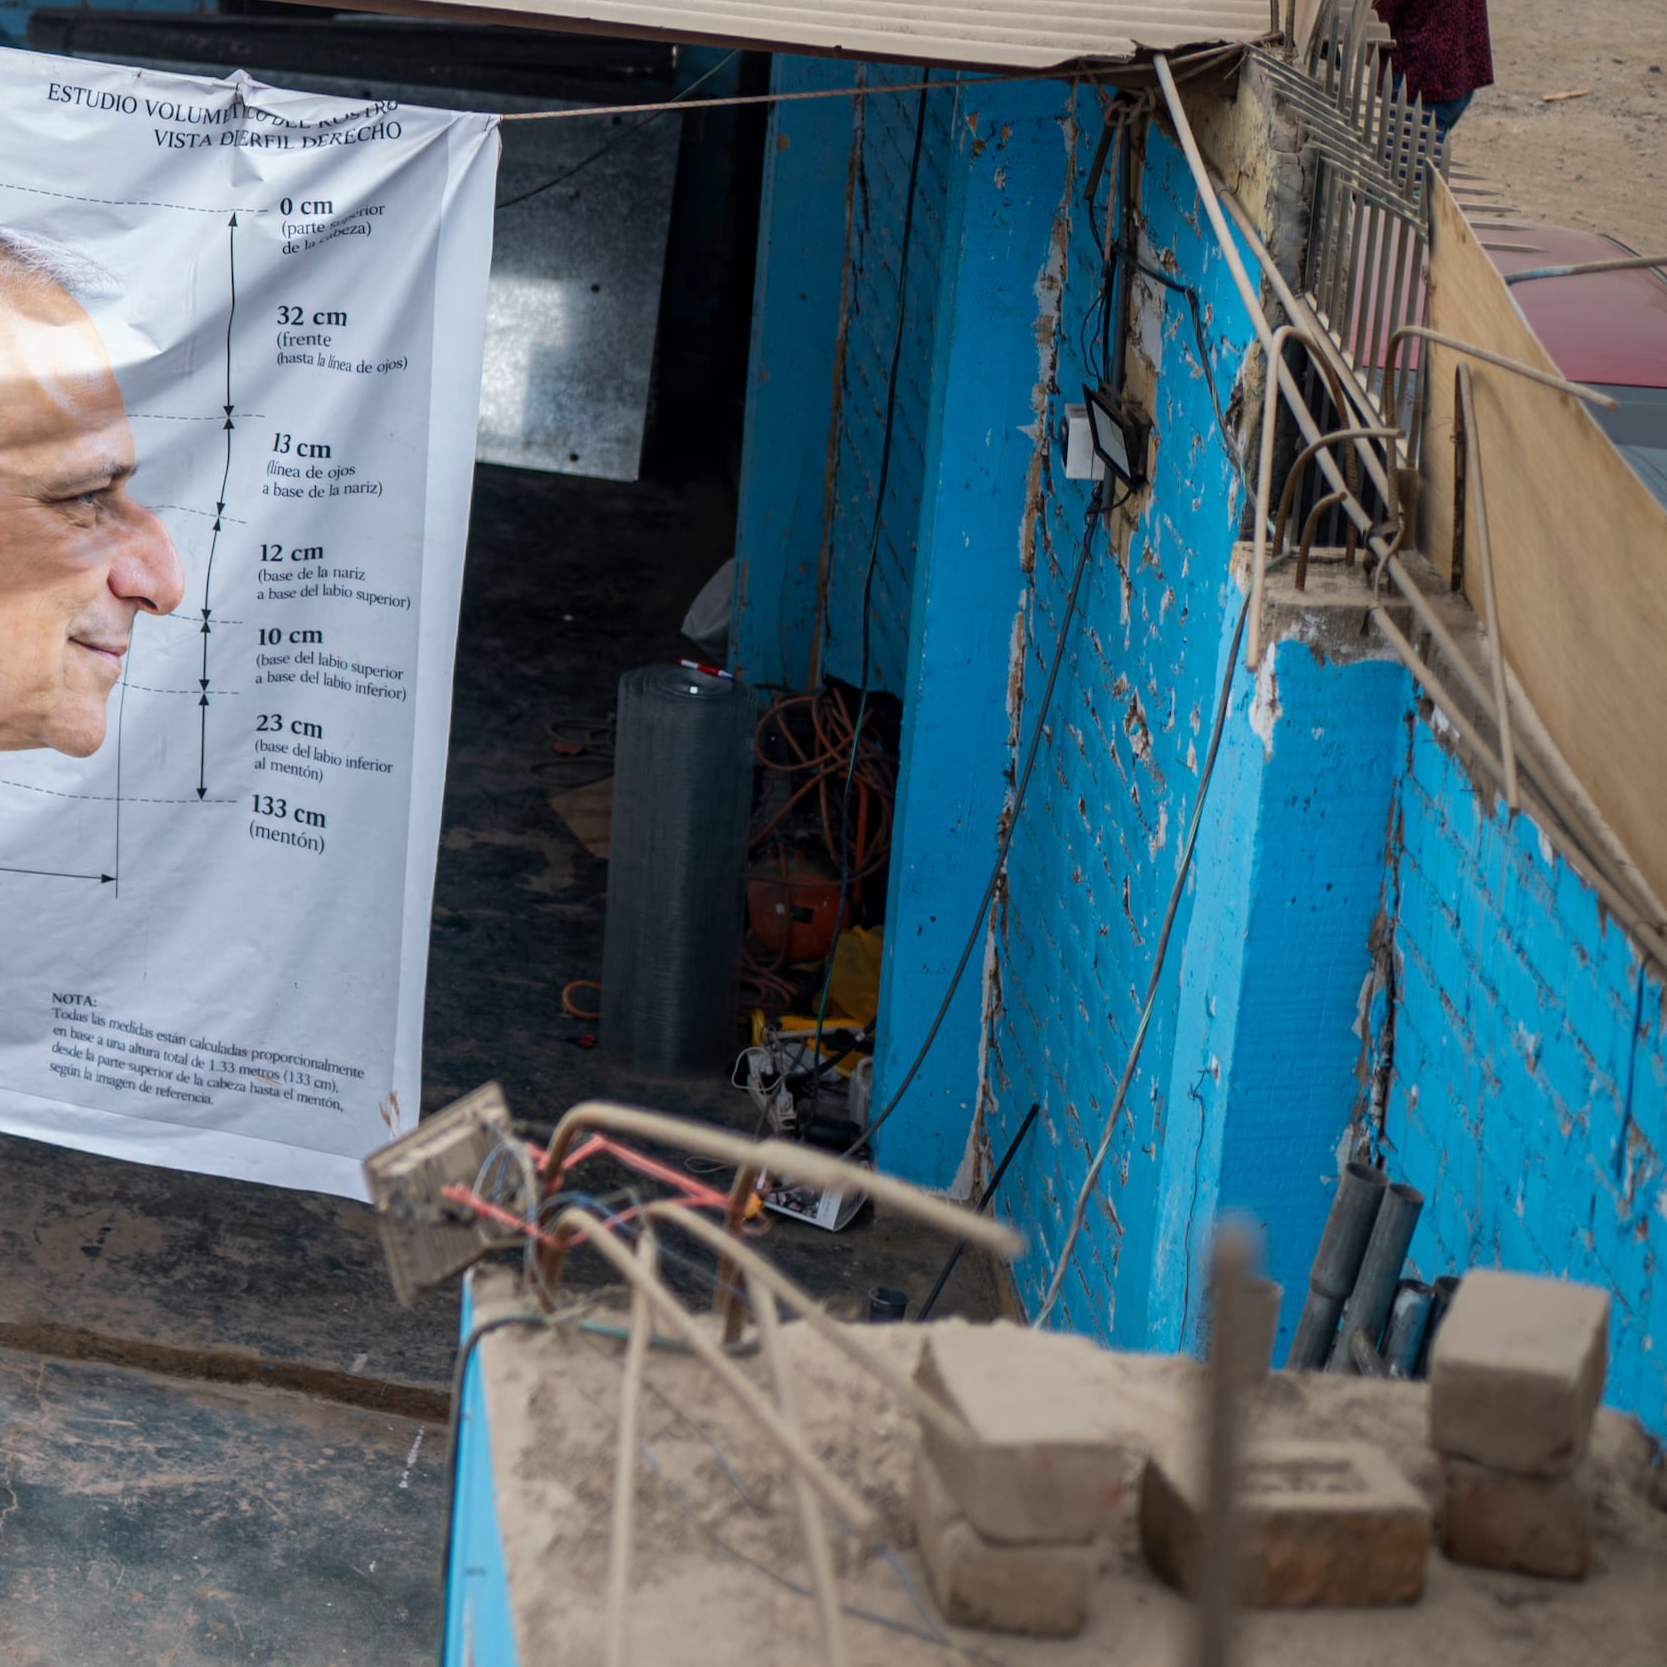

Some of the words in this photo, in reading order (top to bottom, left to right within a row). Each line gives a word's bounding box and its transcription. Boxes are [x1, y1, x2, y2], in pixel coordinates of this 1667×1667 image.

[48, 84, 138, 114] ESTUDIO
[155, 129, 213, 149] VISTA
[302, 121, 402, 149] DERECHO
[280, 198, 293, 215] 0
[301, 200, 333, 215] cm
[282, 221, 325, 238] (parte
[282, 242, 300, 254] de
[305, 240, 315, 250] la
[277, 305, 304, 325] 32
[313, 311, 347, 326] cm
[277, 331, 331, 349] (frente
[277, 352, 314, 366] (hasta
[317, 352, 325, 367] la
[327, 354, 352, 372] línea
[356, 360, 372, 373] de
[377, 356, 408, 374] ojos)
[273, 432, 291, 453] 13
[297, 443, 331, 458] cm
[267, 460, 300, 477] (línea
[306, 465, 323, 479] de
[328, 465, 355, 481] ojos
[263, 485, 269, 494] a
[273, 482, 303, 497] base
[308, 485, 325, 498] de
[329, 484, 339, 496] la
[344, 481, 383, 497] nariz)
[260, 544, 283, 562] 12
[291, 546, 324, 561] cm
[258, 569, 293, 583] (base
[297, 567, 313, 580] de
[318, 566, 328, 578] la
[333, 567, 366, 581] nariz
[257, 591, 264, 600] a
[269, 588, 297, 599] base
[300, 584, 318, 597] del
[323, 583, 352, 597] labio
[356, 590, 411, 611] superior)
[258, 628, 281, 645] 10
[289, 630, 323, 644] cm
[256, 654, 290, 668] (base
[295, 651, 314, 664] del
[319, 652, 347, 670] labio
[351, 662, 404, 680] superior
[255, 675, 262, 684] a
[267, 671, 295, 683] base
[300, 670, 319, 684] del
[324, 673, 351, 691] labio
[355, 680, 407, 702] inferior)
[256, 714, 283, 731] 23
[291, 719, 322, 739] cm
[255, 739, 288, 753] (base
[292, 743, 311, 758] del
[314, 747, 342, 766] labio
[346, 755, 393, 773] inferior
[254, 757, 265, 770] al
[270, 761, 323, 783] mentón)
[252, 794, 287, 818] 133
[294, 808, 326, 828] cm
[250, 819, 325, 855] (mentón)
[52, 993, 97, 1007] NOTA:
[52, 1008, 88, 1022] Todas
[92, 1012, 106, 1026] las
[109, 1019, 154, 1038] medidas
[156, 1033, 185, 1045] están
[189, 1037, 247, 1057] calculadas
[251, 1049, 365, 1079] proporcionalmente
[53, 1026, 66, 1037] en
[70, 1027, 94, 1043] base
[107, 1039, 125, 1051] una
[129, 1042, 160, 1059] altura
[163, 1051, 188, 1066] total
[191, 1056, 205, 1069] de
[210, 1059, 235, 1073] 1.33
[239, 1065, 280, 1080] metros
[283, 1069, 310, 1085] (133
[314, 1078, 339, 1093] cm),
[49, 1061, 80, 1077] según
[84, 1066, 92, 1081] la
[96, 1072, 140, 1090] imagen
[139, 1081, 153, 1093] de
[155, 1085, 214, 1105] referencia.
[51, 1042, 83, 1059] desde
[86, 1048, 94, 1061] la
[97, 1054, 126, 1070] parte
[128, 1063, 174, 1080] superior
[176, 1070, 190, 1084] de
[194, 1074, 203, 1086] la
[206, 1077, 246, 1092] cabeza
[250, 1082, 280, 1097] hasta
[283, 1088, 293, 1100] el
[296, 1091, 344, 1112] mentón,
